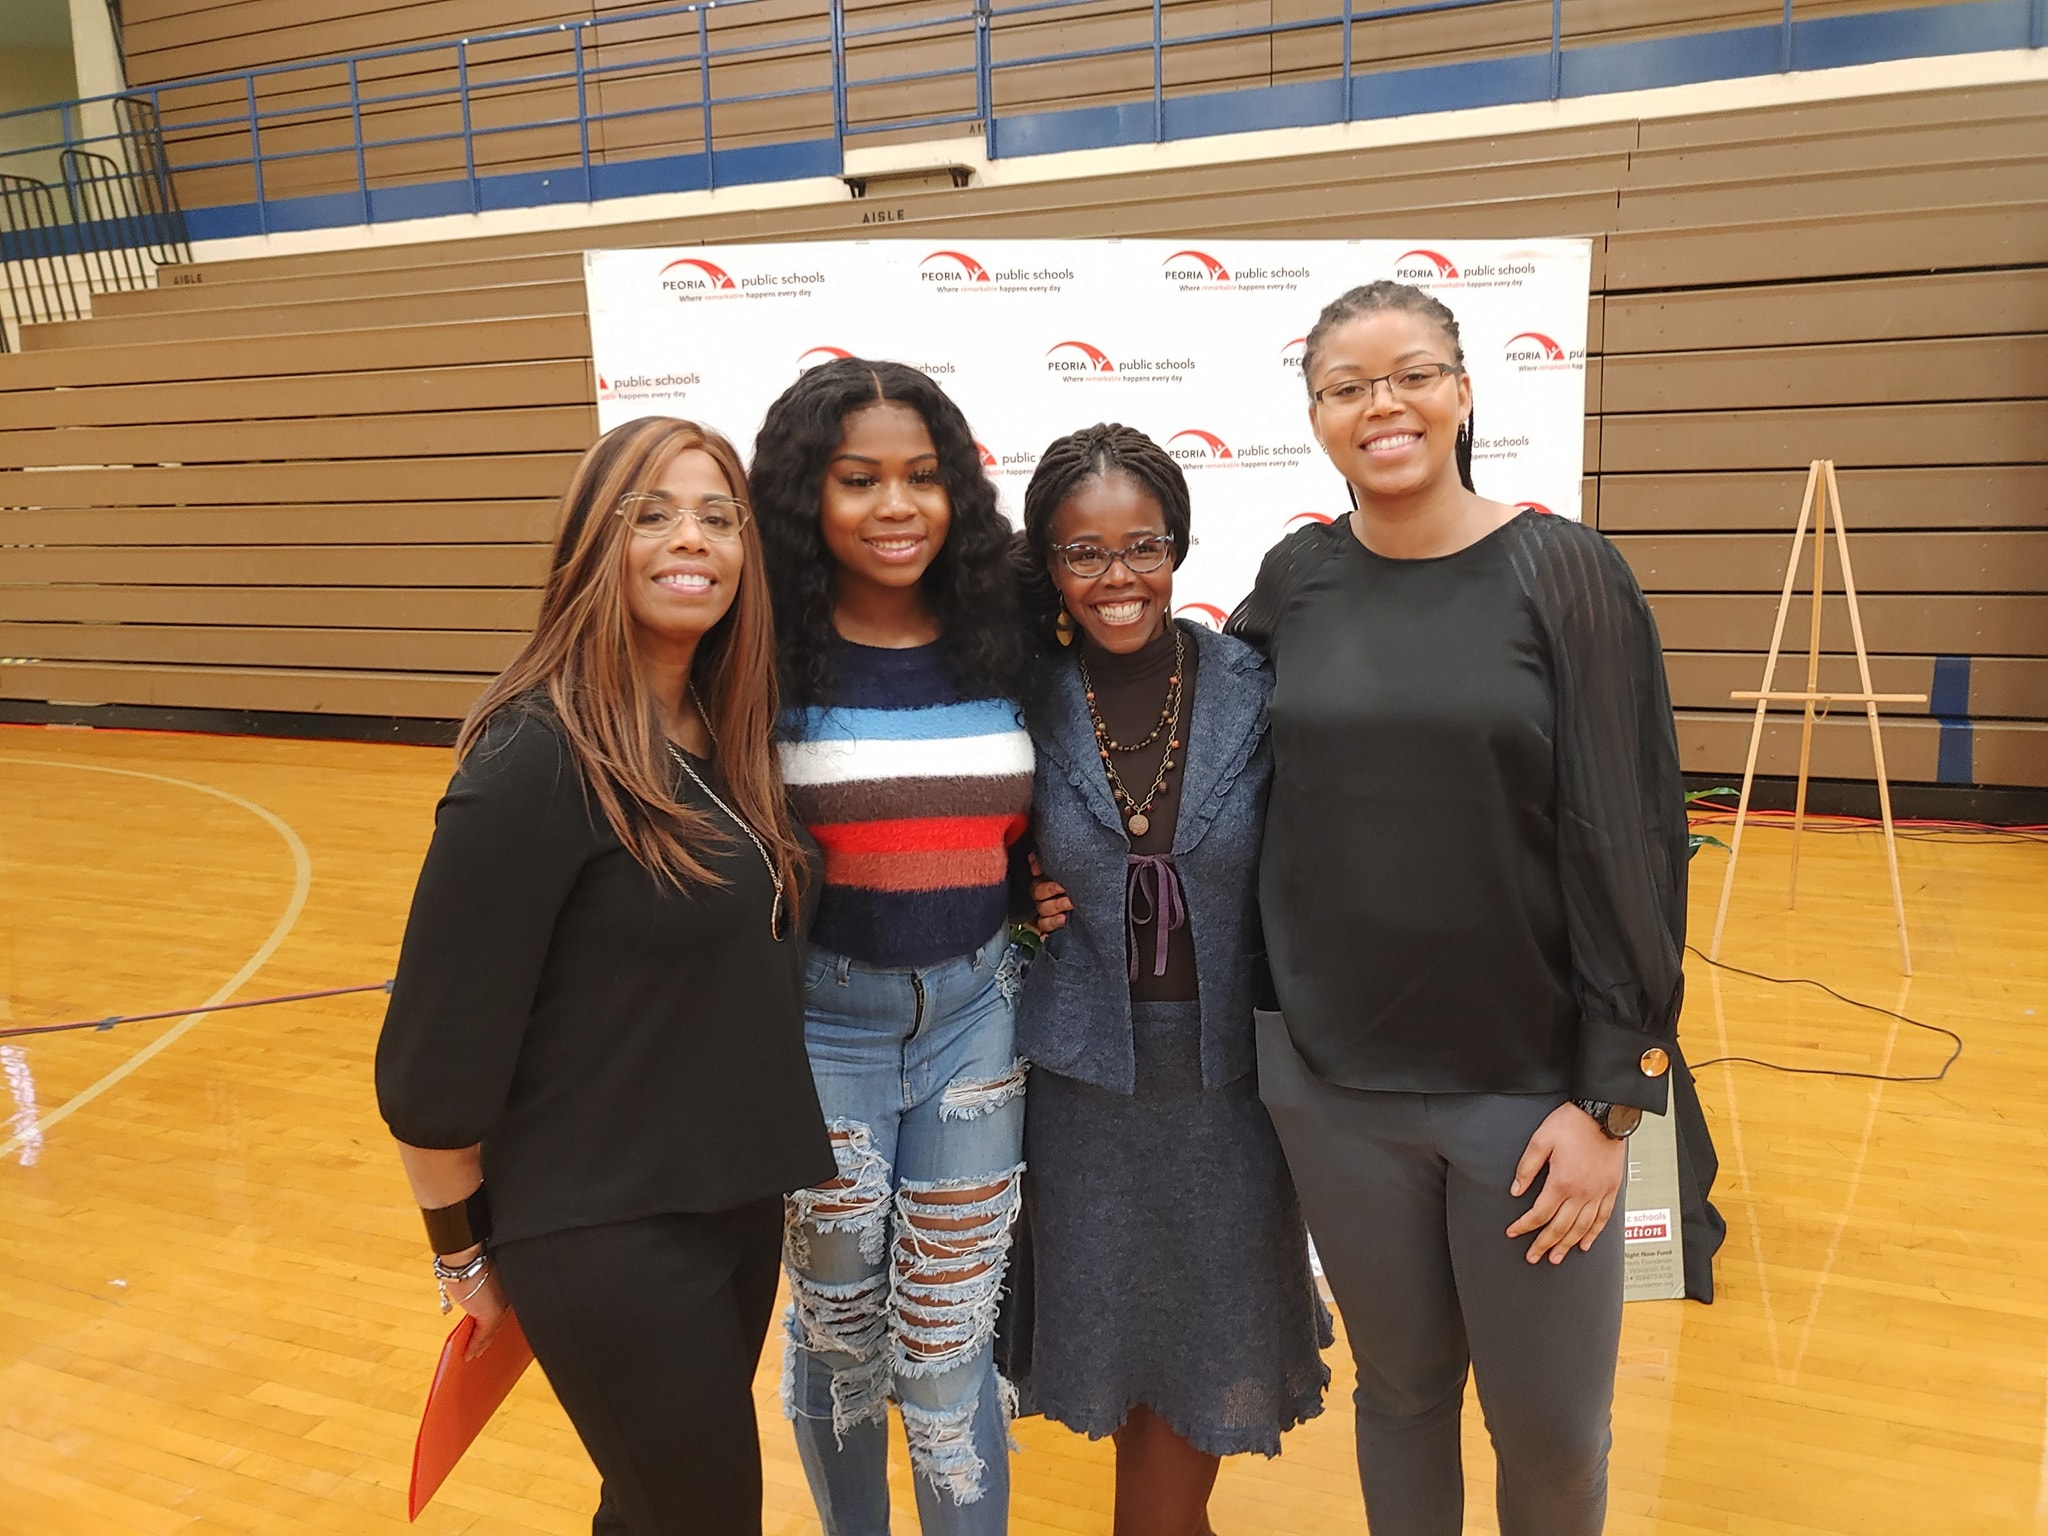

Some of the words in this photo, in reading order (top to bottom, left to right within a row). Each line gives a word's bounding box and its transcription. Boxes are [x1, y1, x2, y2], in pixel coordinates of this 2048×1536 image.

[863, 209, 905, 224] AISLE
[922, 272, 962, 281] PEORIA
[996, 269, 1030, 282] public
[1033, 268, 1074, 280] schools
[1165, 271, 1203, 280] PEORIA
[1235, 267, 1268, 282] public
[1271, 266, 1310, 278] schools
[1397, 269, 1433, 278] PEORIA
[1464, 264, 1495, 279] public
[1498, 262, 1536, 275] schools
[663, 280, 706, 290] PEORIA
[741, 274, 778, 289] public
[782, 272, 825, 285] schools
[1179, 284, 1200, 292] Where
[1238, 283, 1265, 292] happens
[1267, 283, 1284, 291] every
[1286, 282, 1297, 291] day
[1467, 280, 1492, 289] happens
[1494, 280, 1510, 288] every
[1512, 279, 1523, 287] day
[704, 292, 744, 300] remarkable
[746, 290, 776, 299] happens
[778, 290, 797, 298] every
[799, 289, 812, 297] day
[1000, 285, 1027, 293] happens
[1049, 285, 1061, 293] day
[1506, 352, 1541, 361] PEORIA
[1048, 361, 1087, 371] PEORIA
[1119, 359, 1152, 373] public
[1155, 358, 1195, 370] schools
[614, 376, 652, 390] public
[655, 372, 700, 386] schools
[1122, 375, 1150, 383] happens
[1152, 375, 1169, 383] every
[1171, 374, 1182, 382] day
[618, 392, 649, 400] happens
[673, 390, 686, 399] day
[1473, 437, 1490, 449] blic
[1493, 435, 1529, 448] schools
[1169, 450, 1206, 459] PEORIA
[1238, 445, 1269, 459] public
[1272, 443, 1311, 455] schools
[1490, 452, 1505, 460] every
[1507, 451, 1518, 459] day
[1002, 452, 1036, 466] public
[1241, 461, 1267, 469] happens
[1269, 460, 1286, 468] every
[1288, 460, 1299, 468] day
[1634, 1212, 1667, 1222] schools
